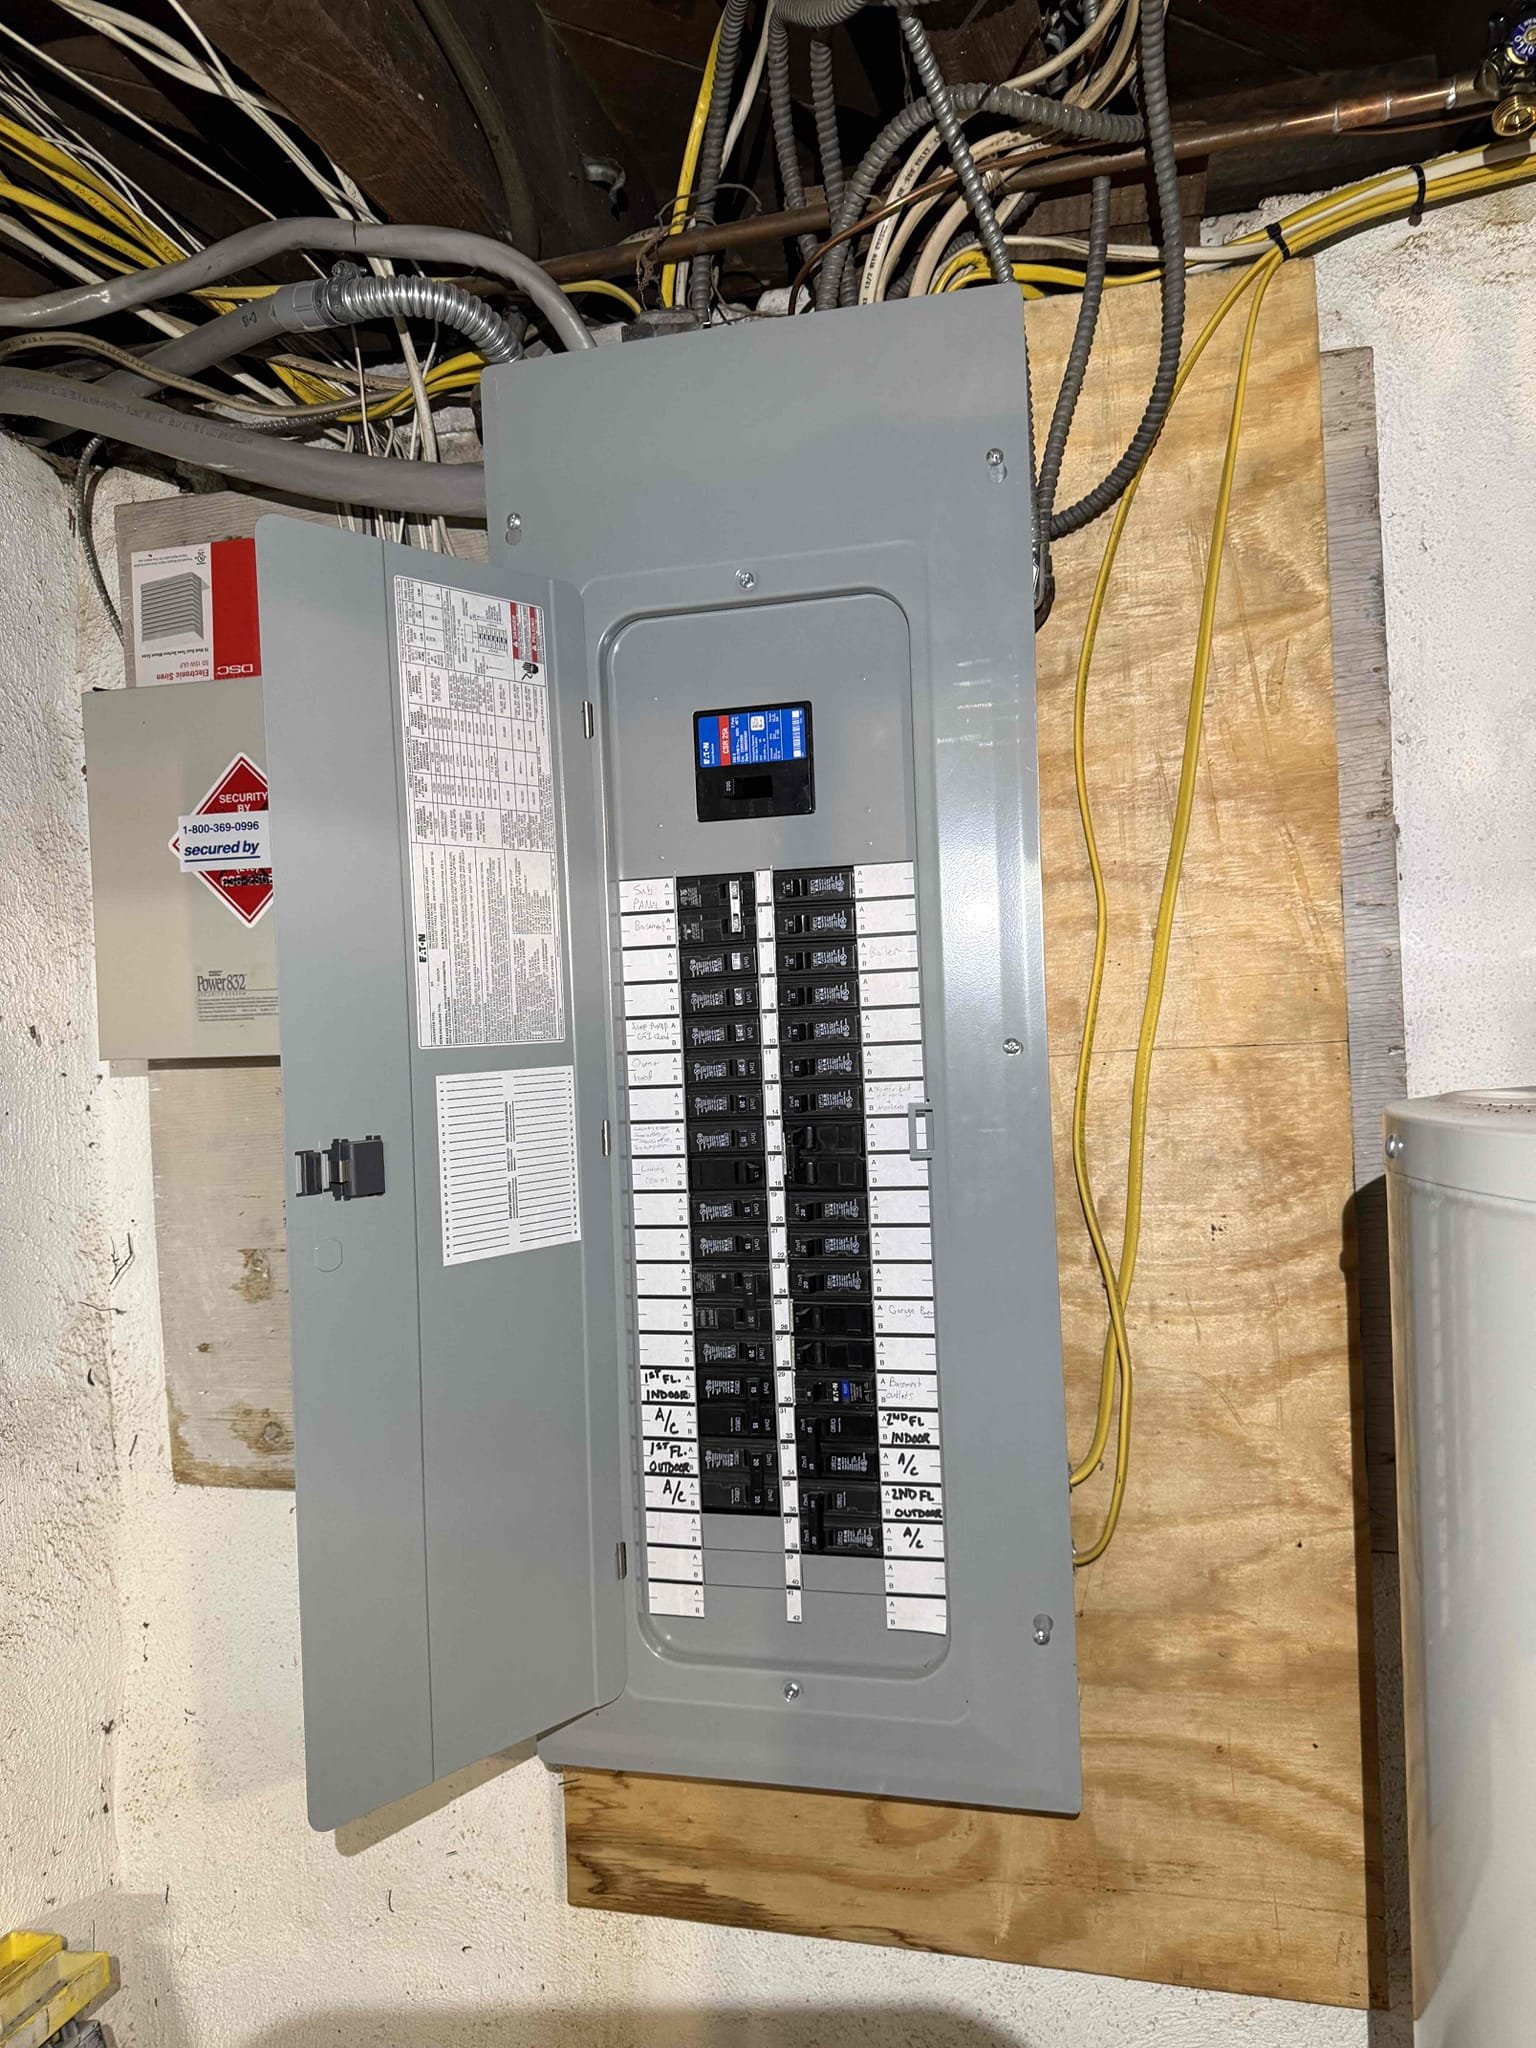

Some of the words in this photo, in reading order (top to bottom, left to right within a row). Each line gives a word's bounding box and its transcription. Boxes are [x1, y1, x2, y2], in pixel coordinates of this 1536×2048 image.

[156, 671, 173, 680] Siren
[176, 669, 209, 679] Electronic
[217, 664, 253, 675] DSC
[219, 791, 268, 804] SECURITY
[183, 821, 259, 834] 1-800-369-0996
[184, 840, 240, 856] secured
[243, 840, 259, 854] by
[647, 1389, 689, 1400] INDOOR
[655, 1407, 679, 1435] A/C
[891, 1432, 930, 1444] INDOOR
[650, 1461, 690, 1473] OUTDOOR
[898, 1453, 919, 1476] A/C
[663, 1479, 686, 1505] A/C
[892, 1488, 917, 1500] 2ND
[919, 1490, 934, 1501] FL
[895, 1509, 942, 1519] OUTDOOR
[903, 1526, 924, 1549] A/C
